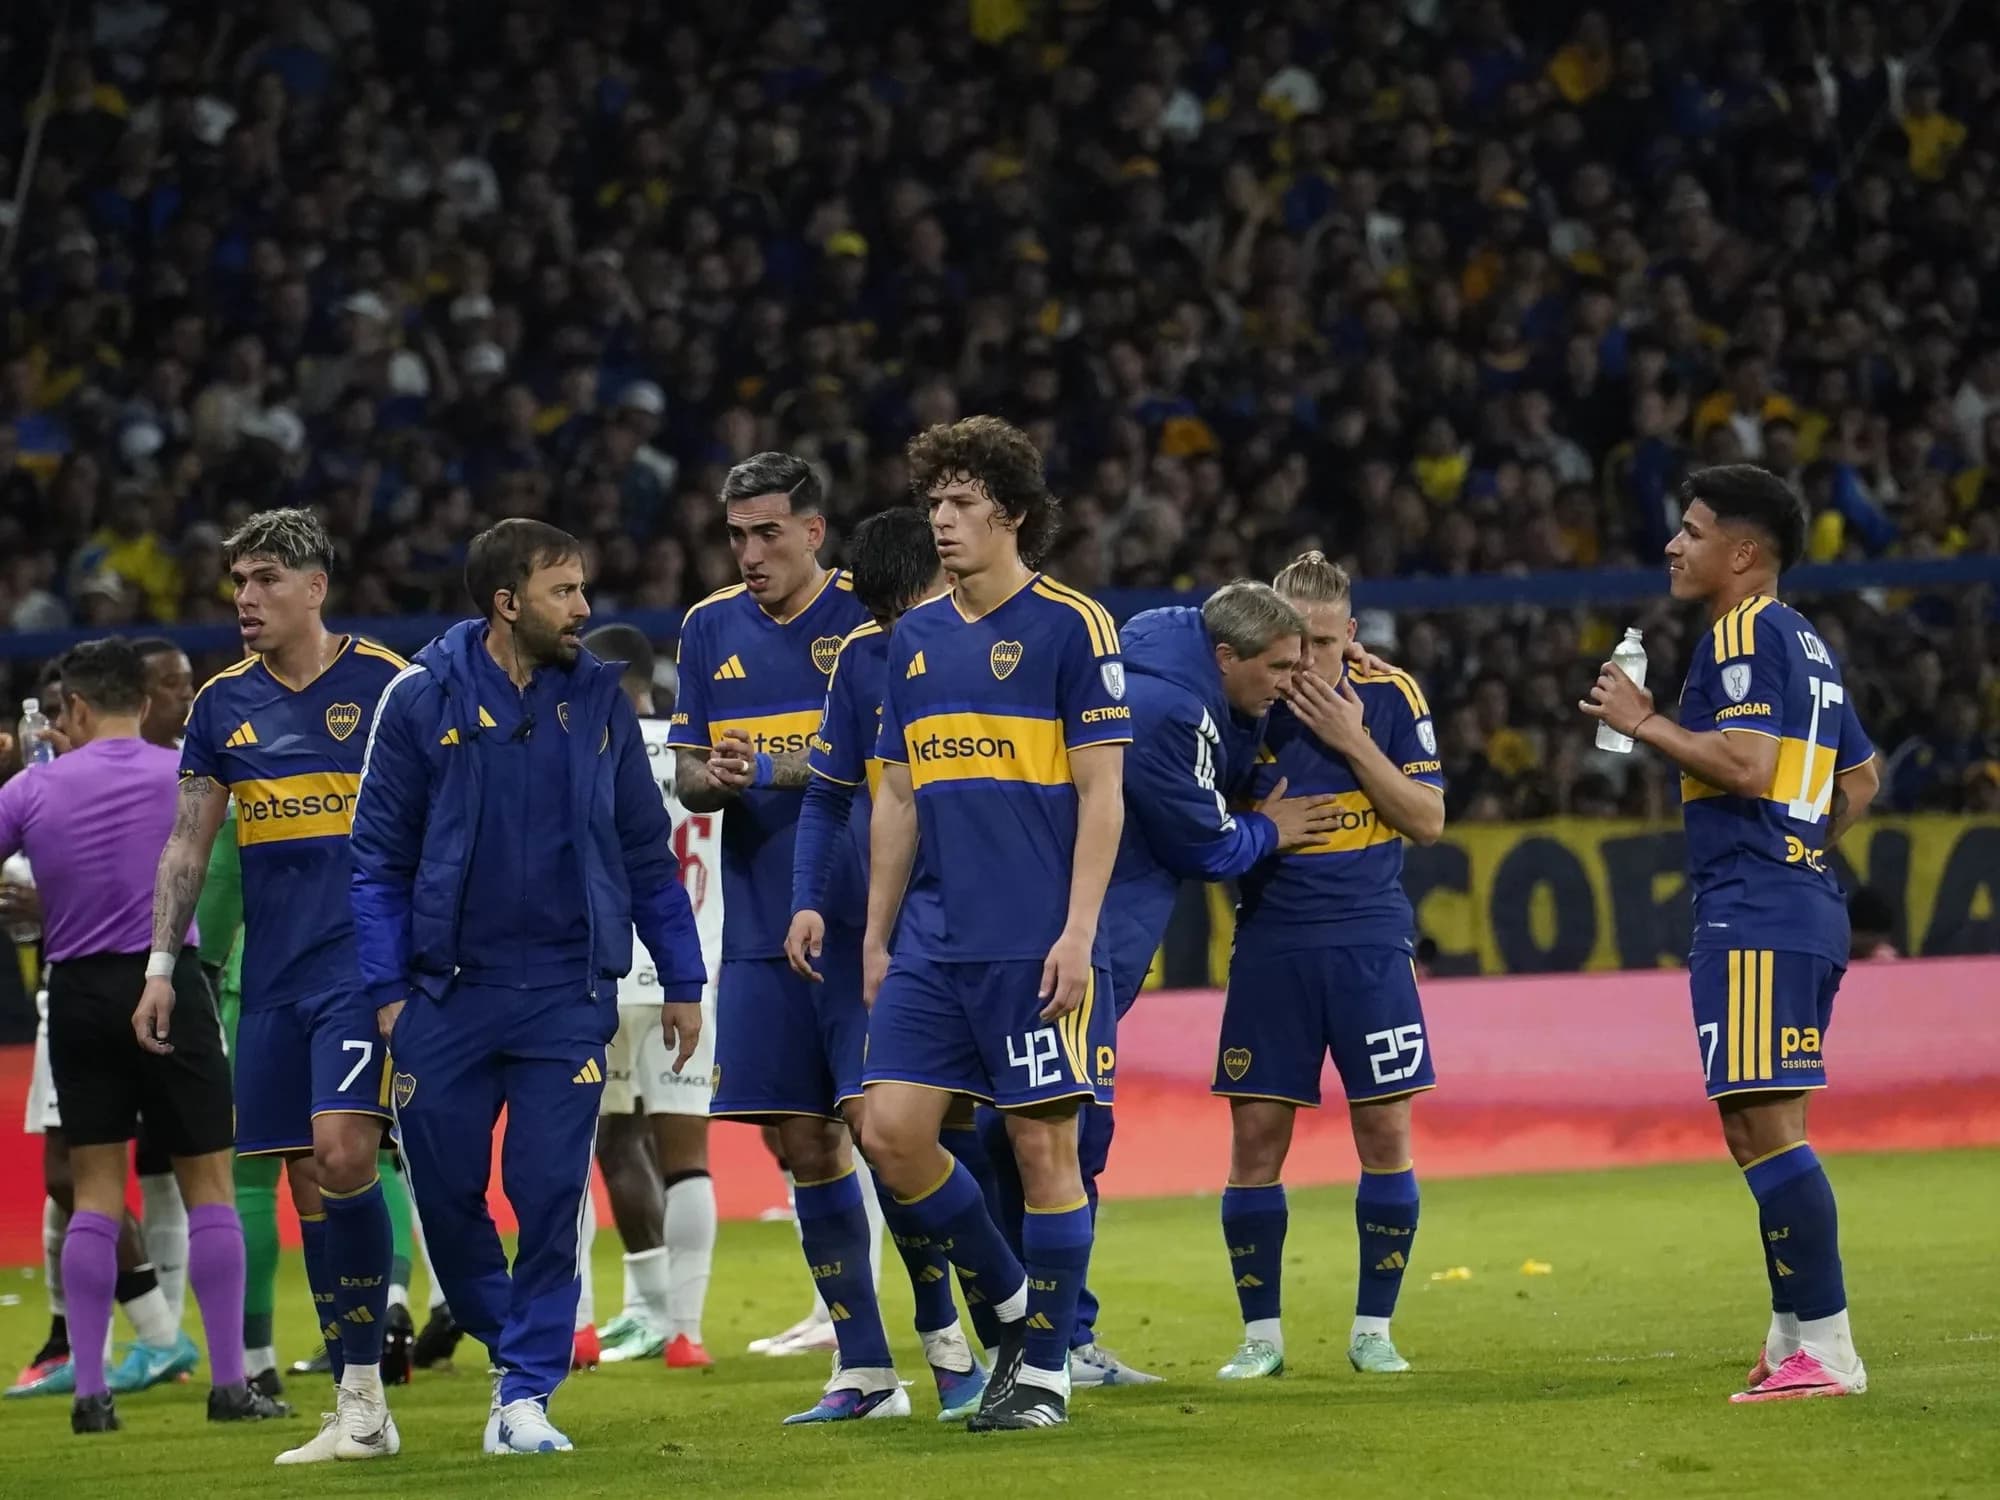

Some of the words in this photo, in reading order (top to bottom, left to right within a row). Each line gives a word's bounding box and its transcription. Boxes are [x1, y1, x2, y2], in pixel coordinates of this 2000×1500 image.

[994, 652, 1017, 661] CABJ
[329, 714, 357, 724] CABJ
[1006, 1027, 1063, 1088] 42
[1365, 1023, 1424, 1085] 25
[337, 1039, 373, 1092] 7
[1227, 1058, 1247, 1067] CABJ
[1097, 1077, 1115, 1087] ass
[810, 1261, 842, 1279] ABJ
